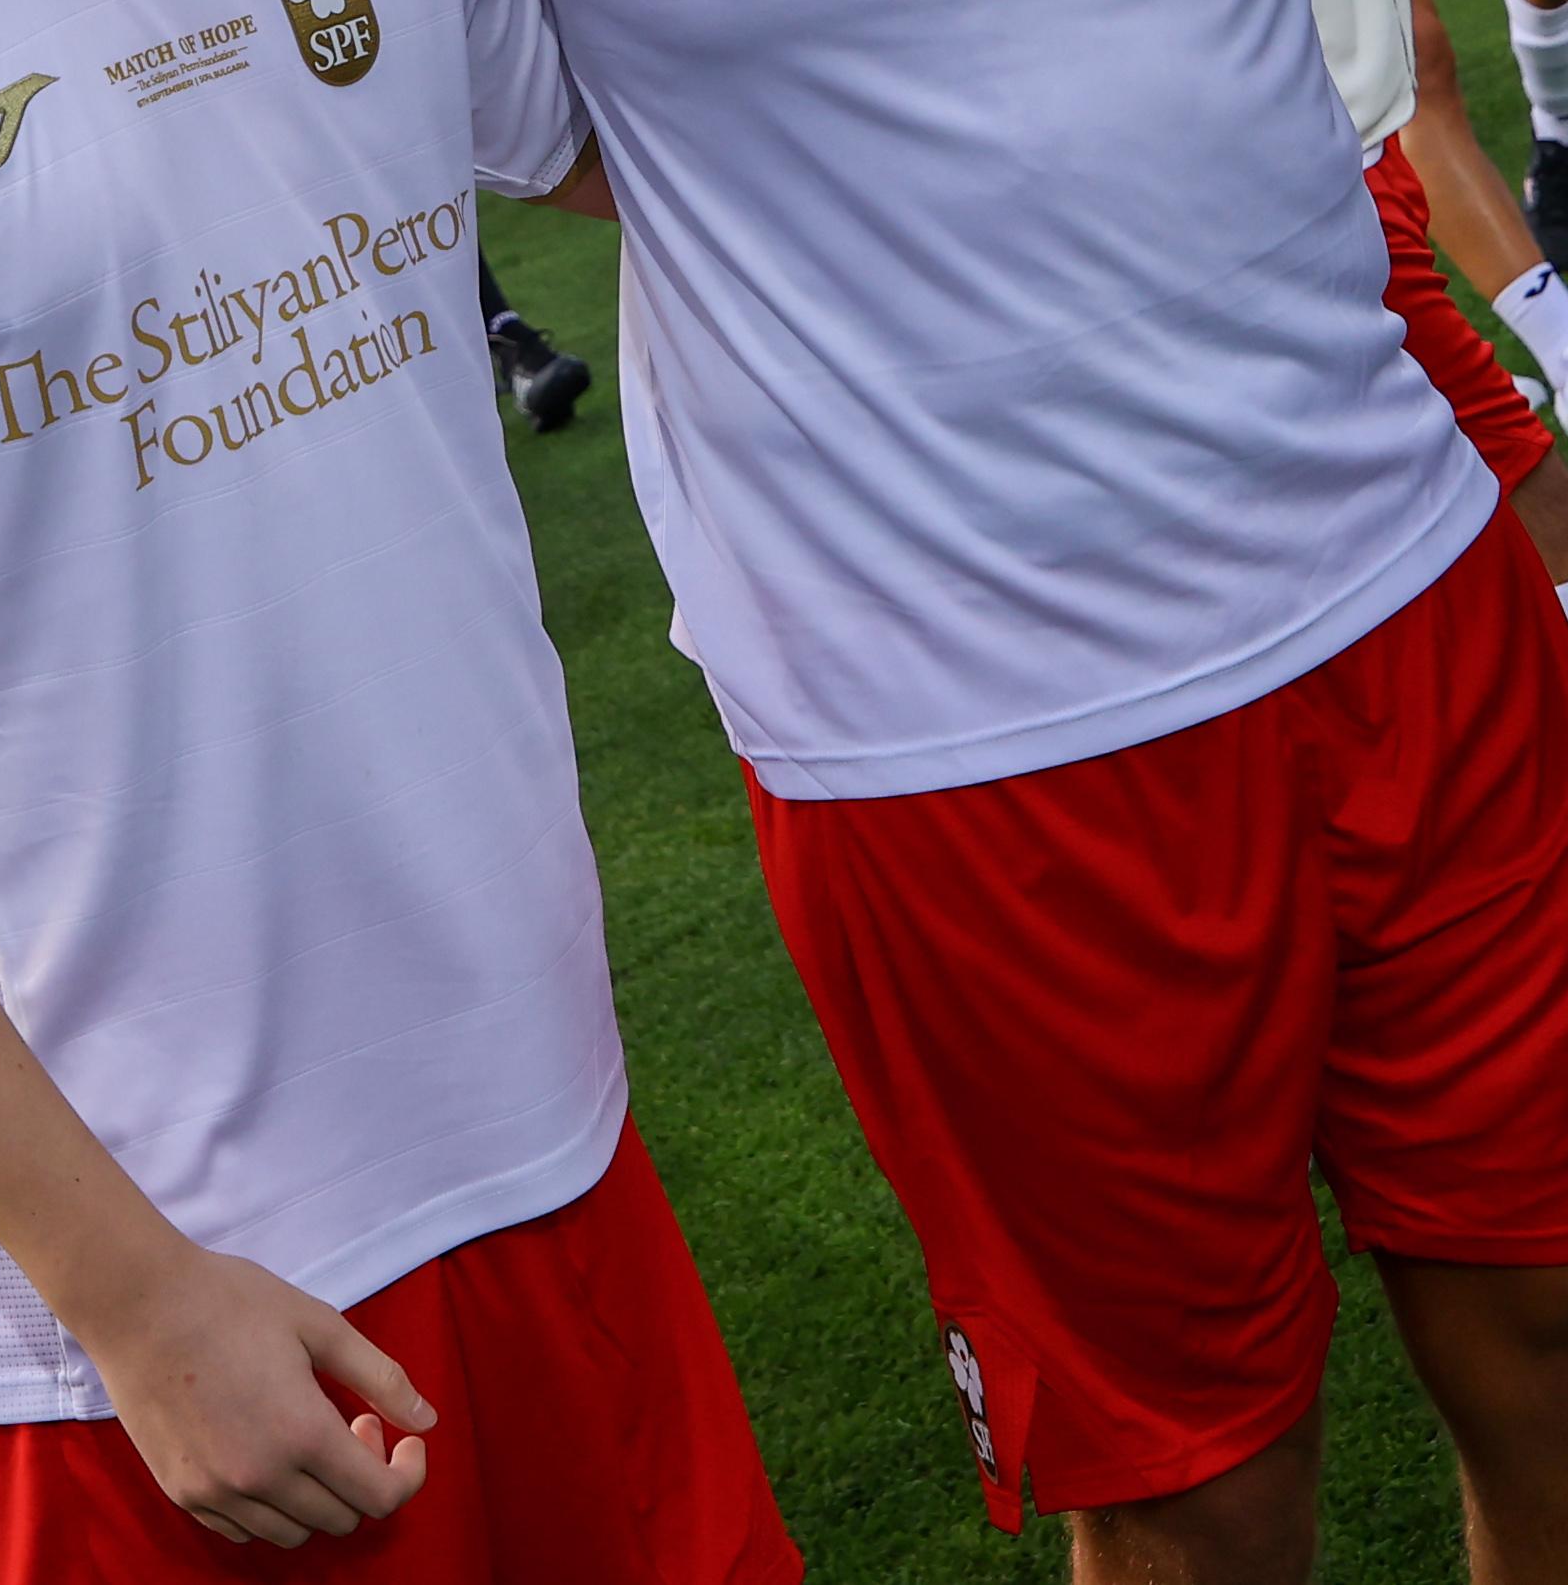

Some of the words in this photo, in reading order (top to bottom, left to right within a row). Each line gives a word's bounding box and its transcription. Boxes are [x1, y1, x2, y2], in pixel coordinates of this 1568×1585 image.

[103, 41, 176, 85] MATCH
[177, 34, 197, 55] OF
[198, 14, 258, 50] HOPE
[310, 15, 371, 72] SPF
[131, 254, 347, 384] Stiliyan
[323, 189, 469, 290] Petrov
[120, 308, 438, 492] Foundation
